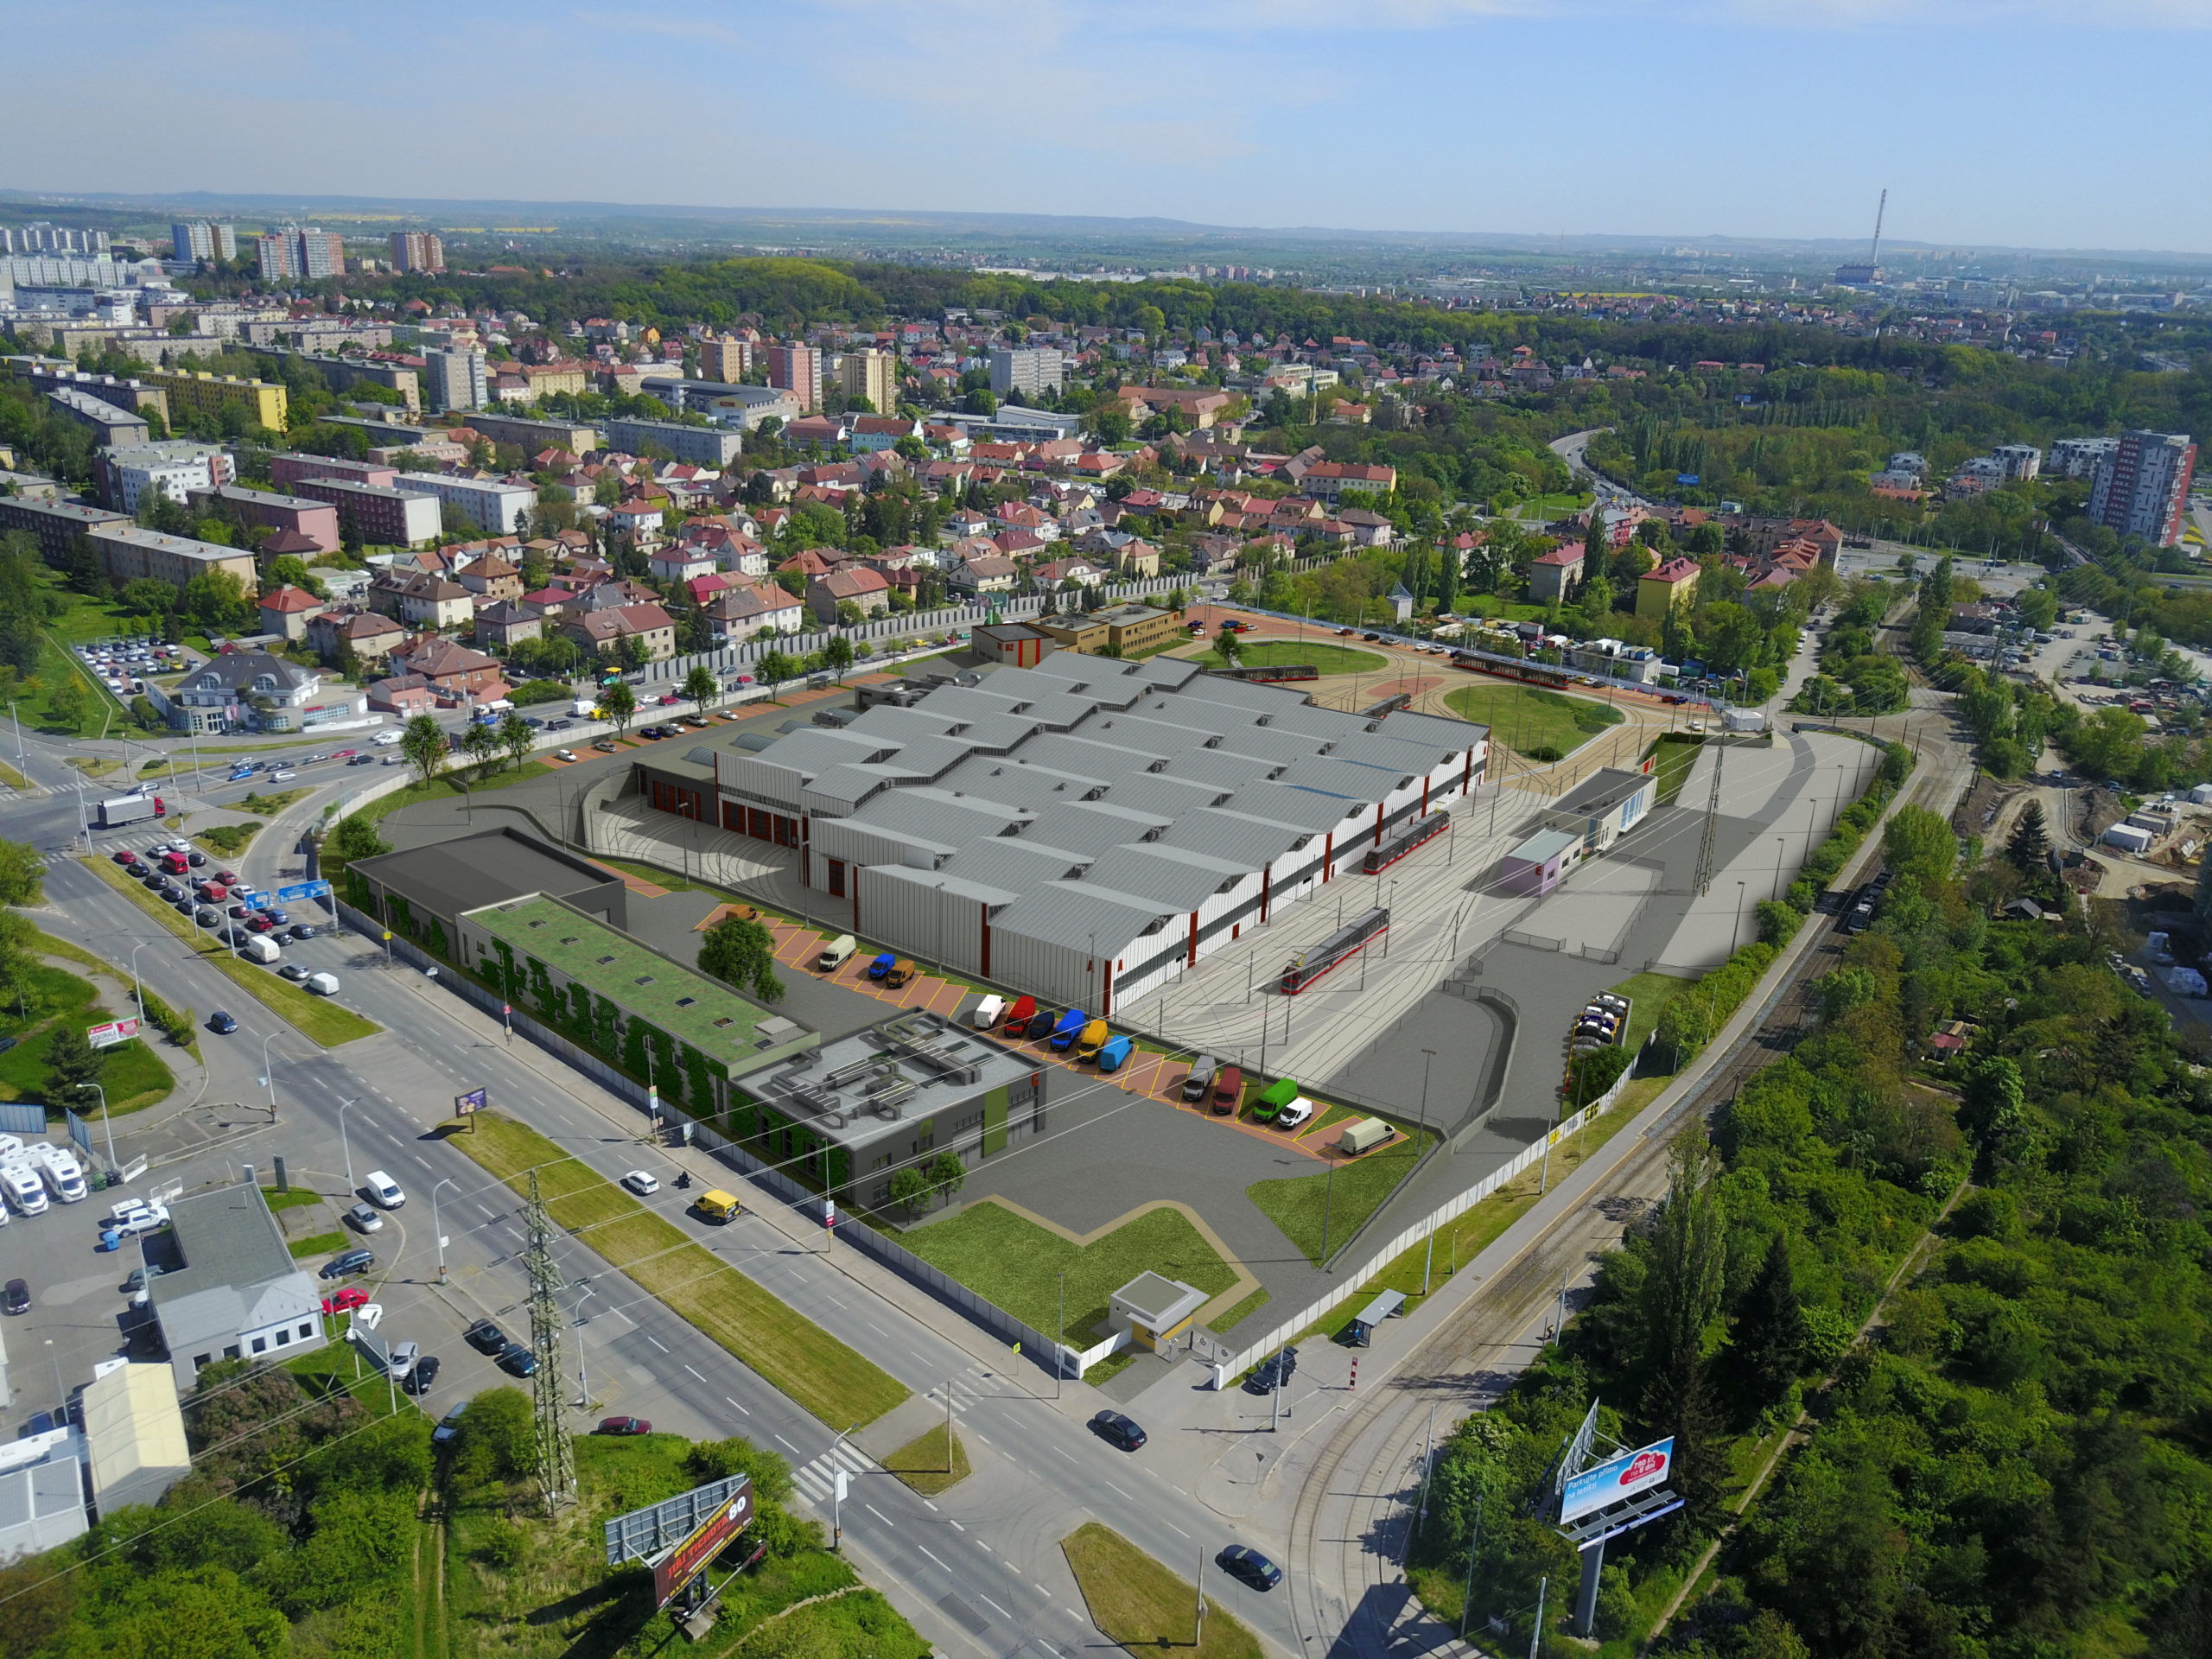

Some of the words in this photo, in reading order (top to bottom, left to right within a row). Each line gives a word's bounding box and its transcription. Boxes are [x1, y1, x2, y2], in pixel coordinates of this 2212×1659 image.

[1568, 1474, 1597, 1490] Parkujte
[688, 1516, 728, 1556] TICHOTA
[728, 1496, 747, 1521] 80
